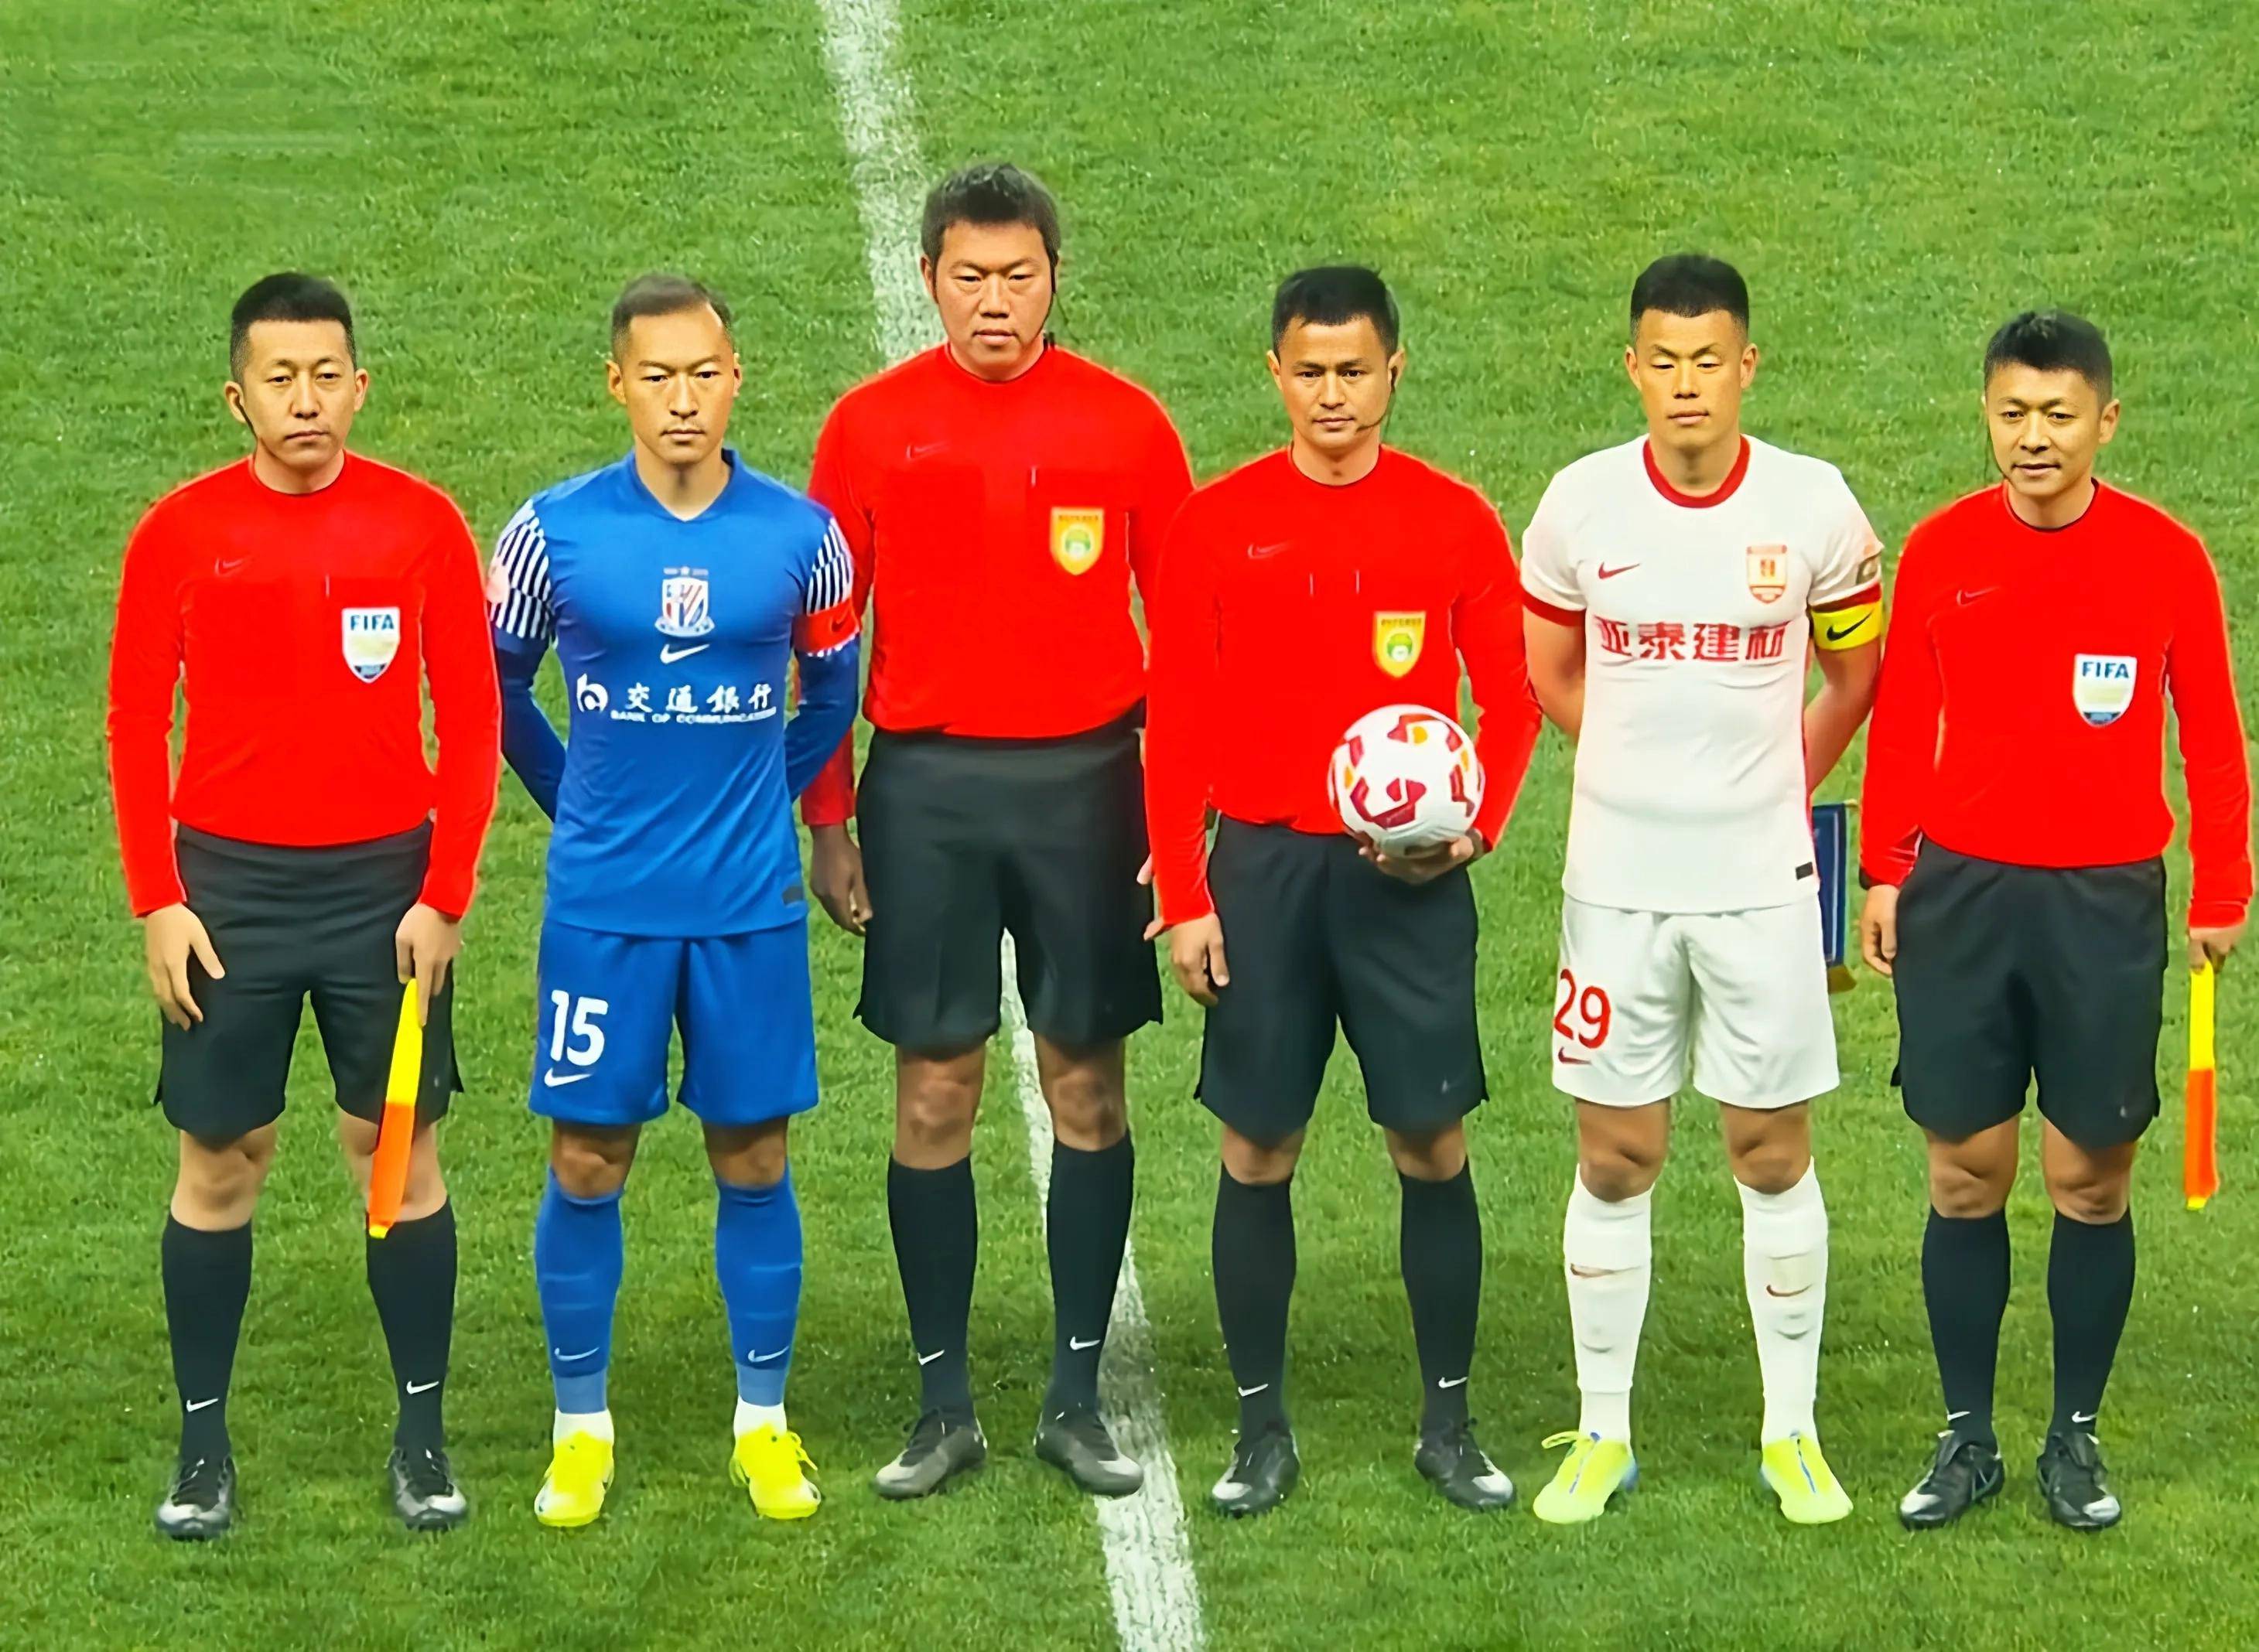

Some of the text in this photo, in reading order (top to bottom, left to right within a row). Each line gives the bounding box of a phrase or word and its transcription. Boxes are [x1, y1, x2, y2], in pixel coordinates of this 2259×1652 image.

[350, 613, 395, 631] FIFA
[2082, 661, 2130, 679] FIFA
[610, 706, 777, 724] BANK OF COMMUNICA
[1553, 968, 1611, 1049] 29
[550, 989, 609, 1067] 15
